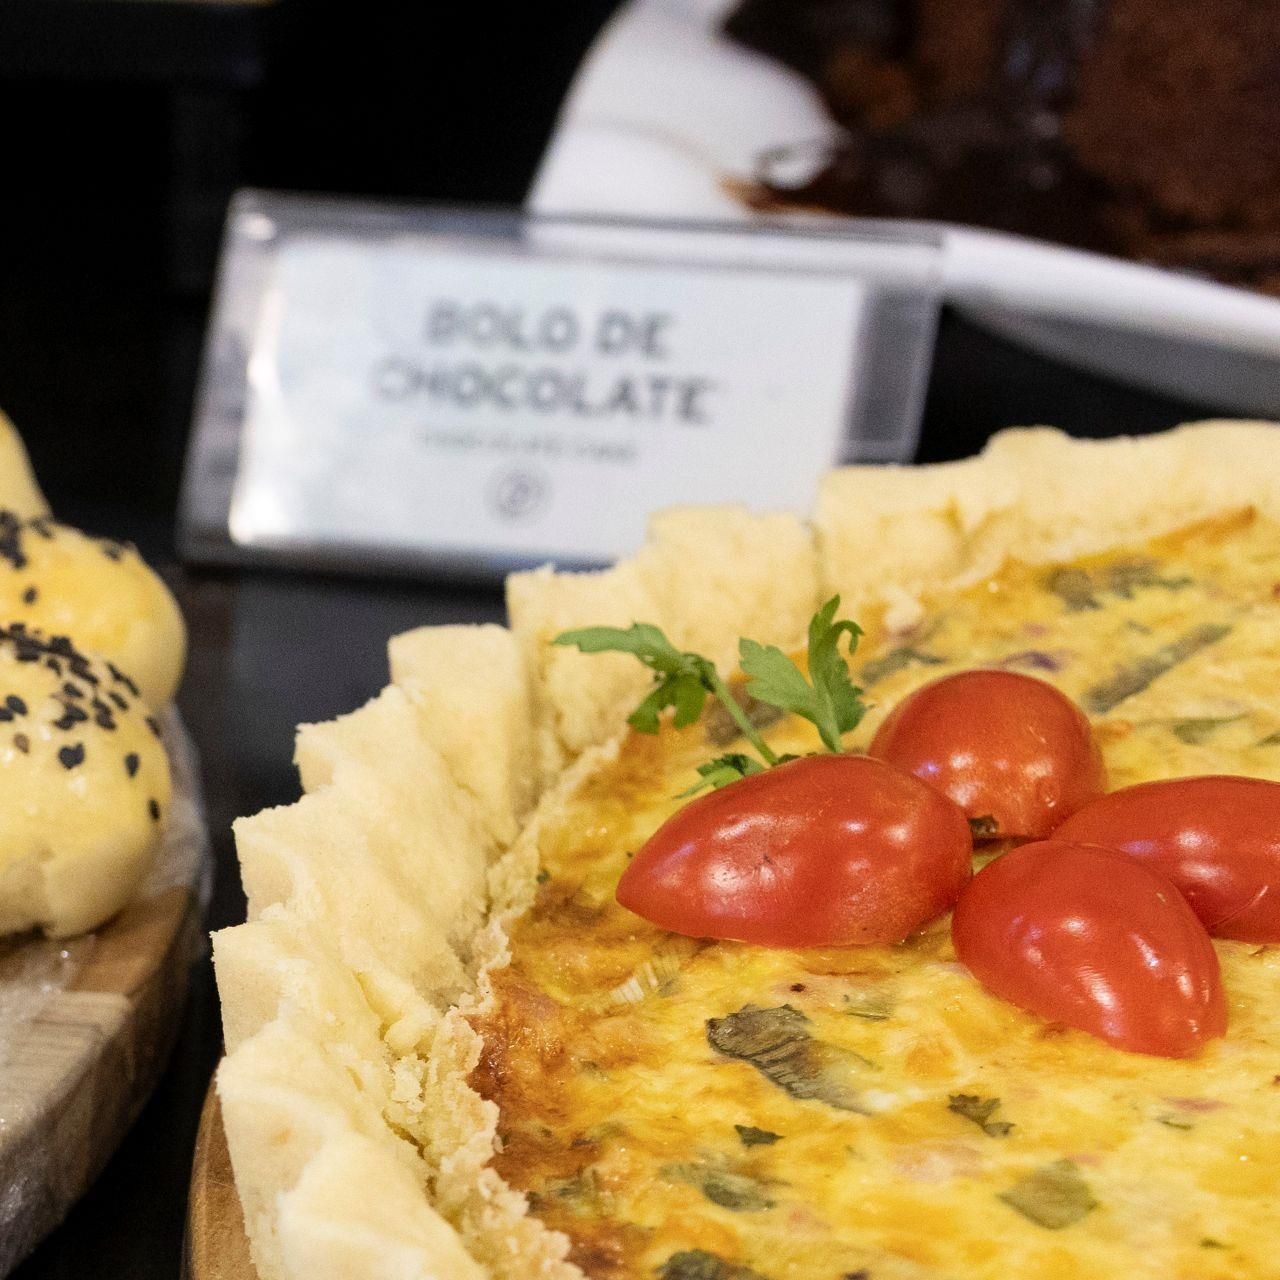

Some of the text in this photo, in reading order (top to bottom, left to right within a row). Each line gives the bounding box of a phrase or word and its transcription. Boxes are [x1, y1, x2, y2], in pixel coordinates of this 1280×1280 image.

[424, 296, 676, 361] BOLO DE
[372, 355, 723, 427] CHOCOLATE
